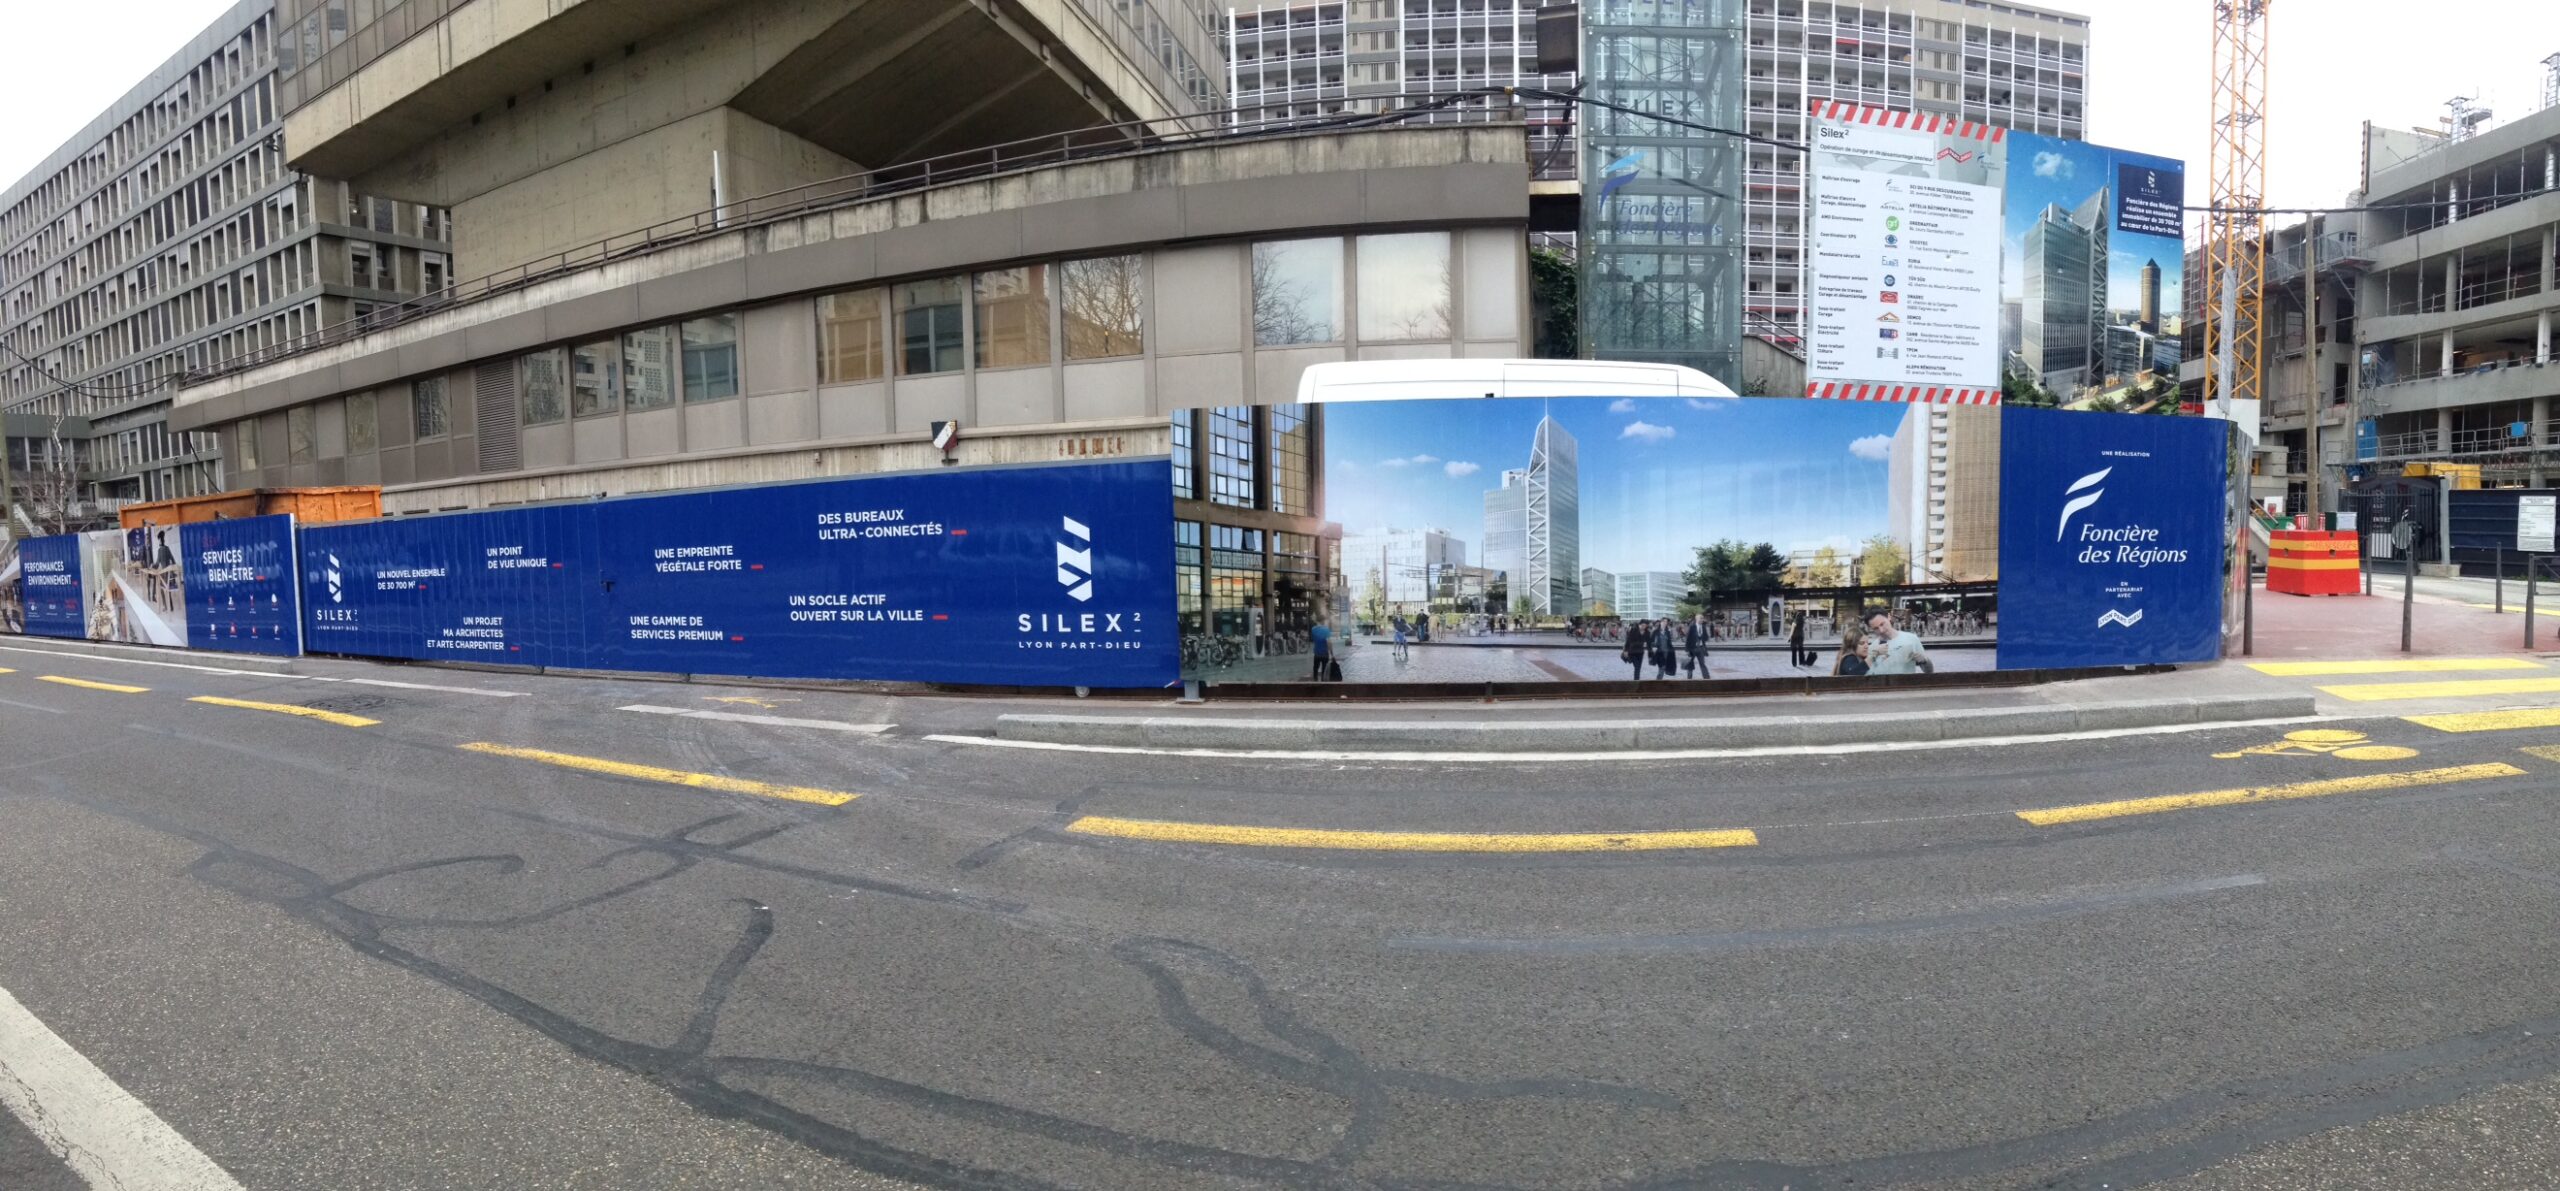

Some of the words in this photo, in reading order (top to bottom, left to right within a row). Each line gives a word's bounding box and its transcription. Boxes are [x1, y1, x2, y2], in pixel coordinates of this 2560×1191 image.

[1619, 200, 1693, 217] Foncière
[2126, 197, 2148, 206] Foncière
[2159, 202, 2178, 211] Régions
[2122, 212, 2150, 222] immobilier
[2126, 206, 2144, 214] réalise
[2153, 209, 2176, 218] ensemble
[2155, 226, 2179, 235] Part-Dieu
[818, 513, 842, 525] DES
[845, 509, 904, 523] BUREAUX
[2080, 523, 2159, 542] Foncière
[202, 550, 243, 564] SERVICES
[487, 548, 498, 557] UN
[499, 546, 523, 556] POINT
[654, 548, 676, 559] UNE
[677, 545, 734, 558] EMPREINTE
[2078, 546, 2111, 563] des
[2116, 545, 2188, 568] Régions
[24, 561, 64, 572] PERFORMANCES
[488, 560, 498, 569] DE
[499, 560, 515, 568] VUE
[516, 558, 547, 569] UNIQUE
[655, 559, 706, 573] VÉGÉTALE
[708, 559, 742, 571] FORTE
[208, 564, 254, 582] BIEN-ÊTRE
[377, 571, 385, 579] UN
[386, 570, 411, 578] NOUVEL
[412, 568, 446, 577] ENSEMBLE
[28, 574, 72, 585] ENVIRONNEMENT
[396, 582, 406, 590] 700
[789, 595, 806, 606] UN
[808, 594, 848, 606] SOCLE
[850, 593, 887, 605] ACTIF
[463, 617, 474, 626] UN
[475, 616, 502, 626] PROJET
[630, 616, 650, 626] UNE
[651, 616, 687, 626] GAMME
[689, 616, 703, 626] DE
[790, 610, 837, 622] OUVERT
[840, 610, 865, 622] SUR
[867, 610, 884, 622] LA
[887, 609, 923, 621] VILLE
[443, 628, 454, 637] MA
[456, 628, 504, 638] ARCHITECTES
[630, 629, 676, 640] SERVICES
[678, 630, 723, 641] PREMIUM
[427, 640, 436, 648] ET
[436, 640, 454, 649] ARTE
[455, 640, 505, 650] CHARPENTIER
[1018, 641, 1053, 649] LYON
[1061, 641, 1141, 649] PART-DIEU
